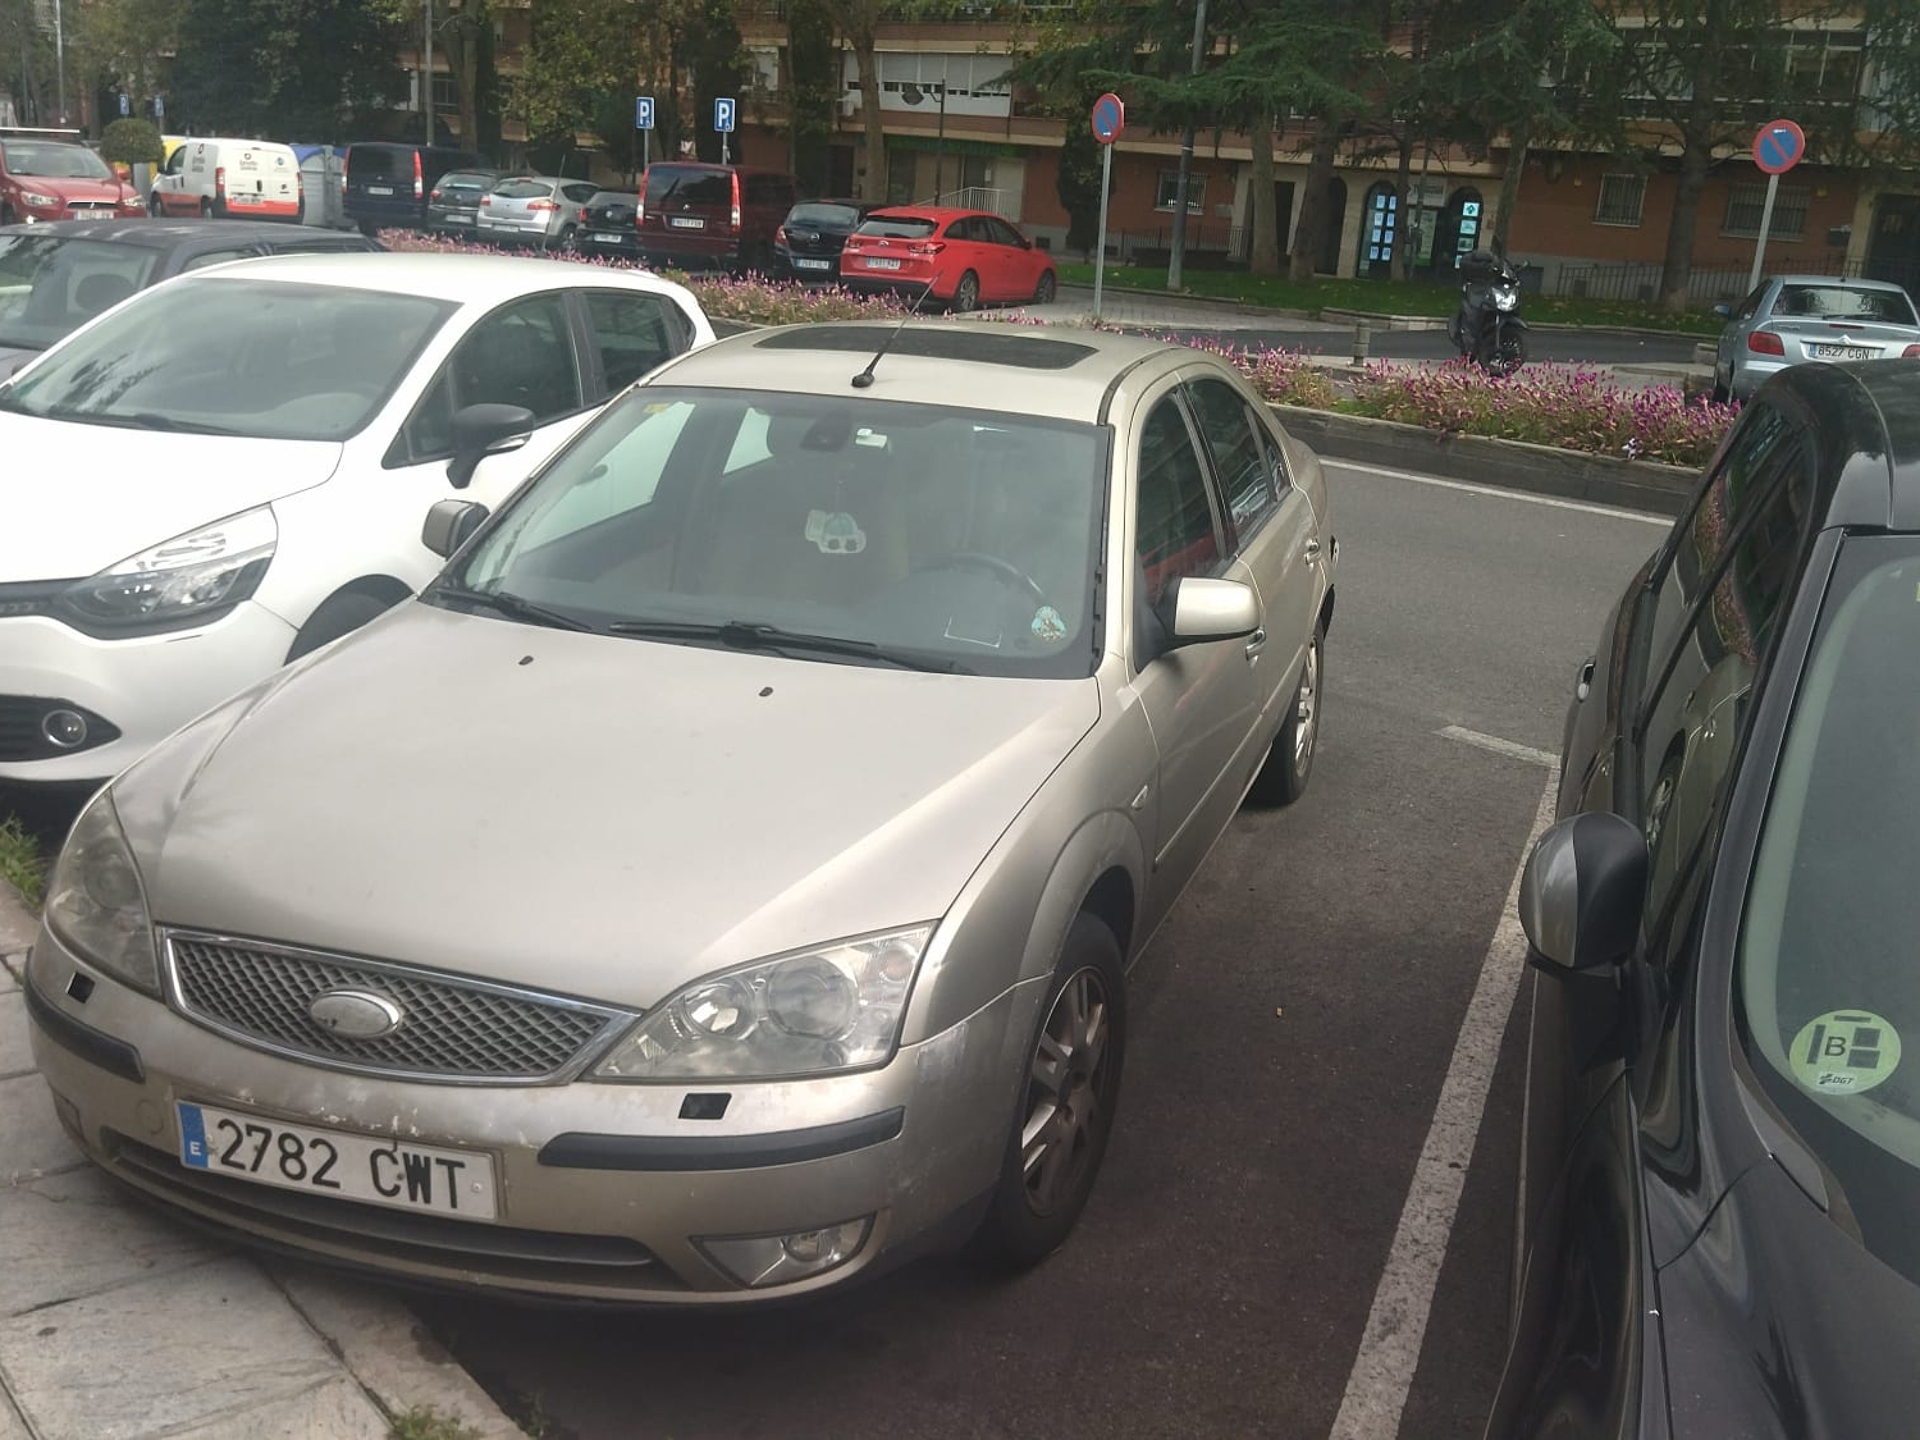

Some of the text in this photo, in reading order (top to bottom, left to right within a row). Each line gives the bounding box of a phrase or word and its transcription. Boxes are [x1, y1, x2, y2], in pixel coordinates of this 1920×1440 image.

[640, 101, 650, 125] P
[718, 102, 730, 128] P
[1818, 346, 1870, 359] 8527 CGN
[1824, 1036, 1846, 1056] B
[190, 1118, 466, 1209] E 2782 CWT
